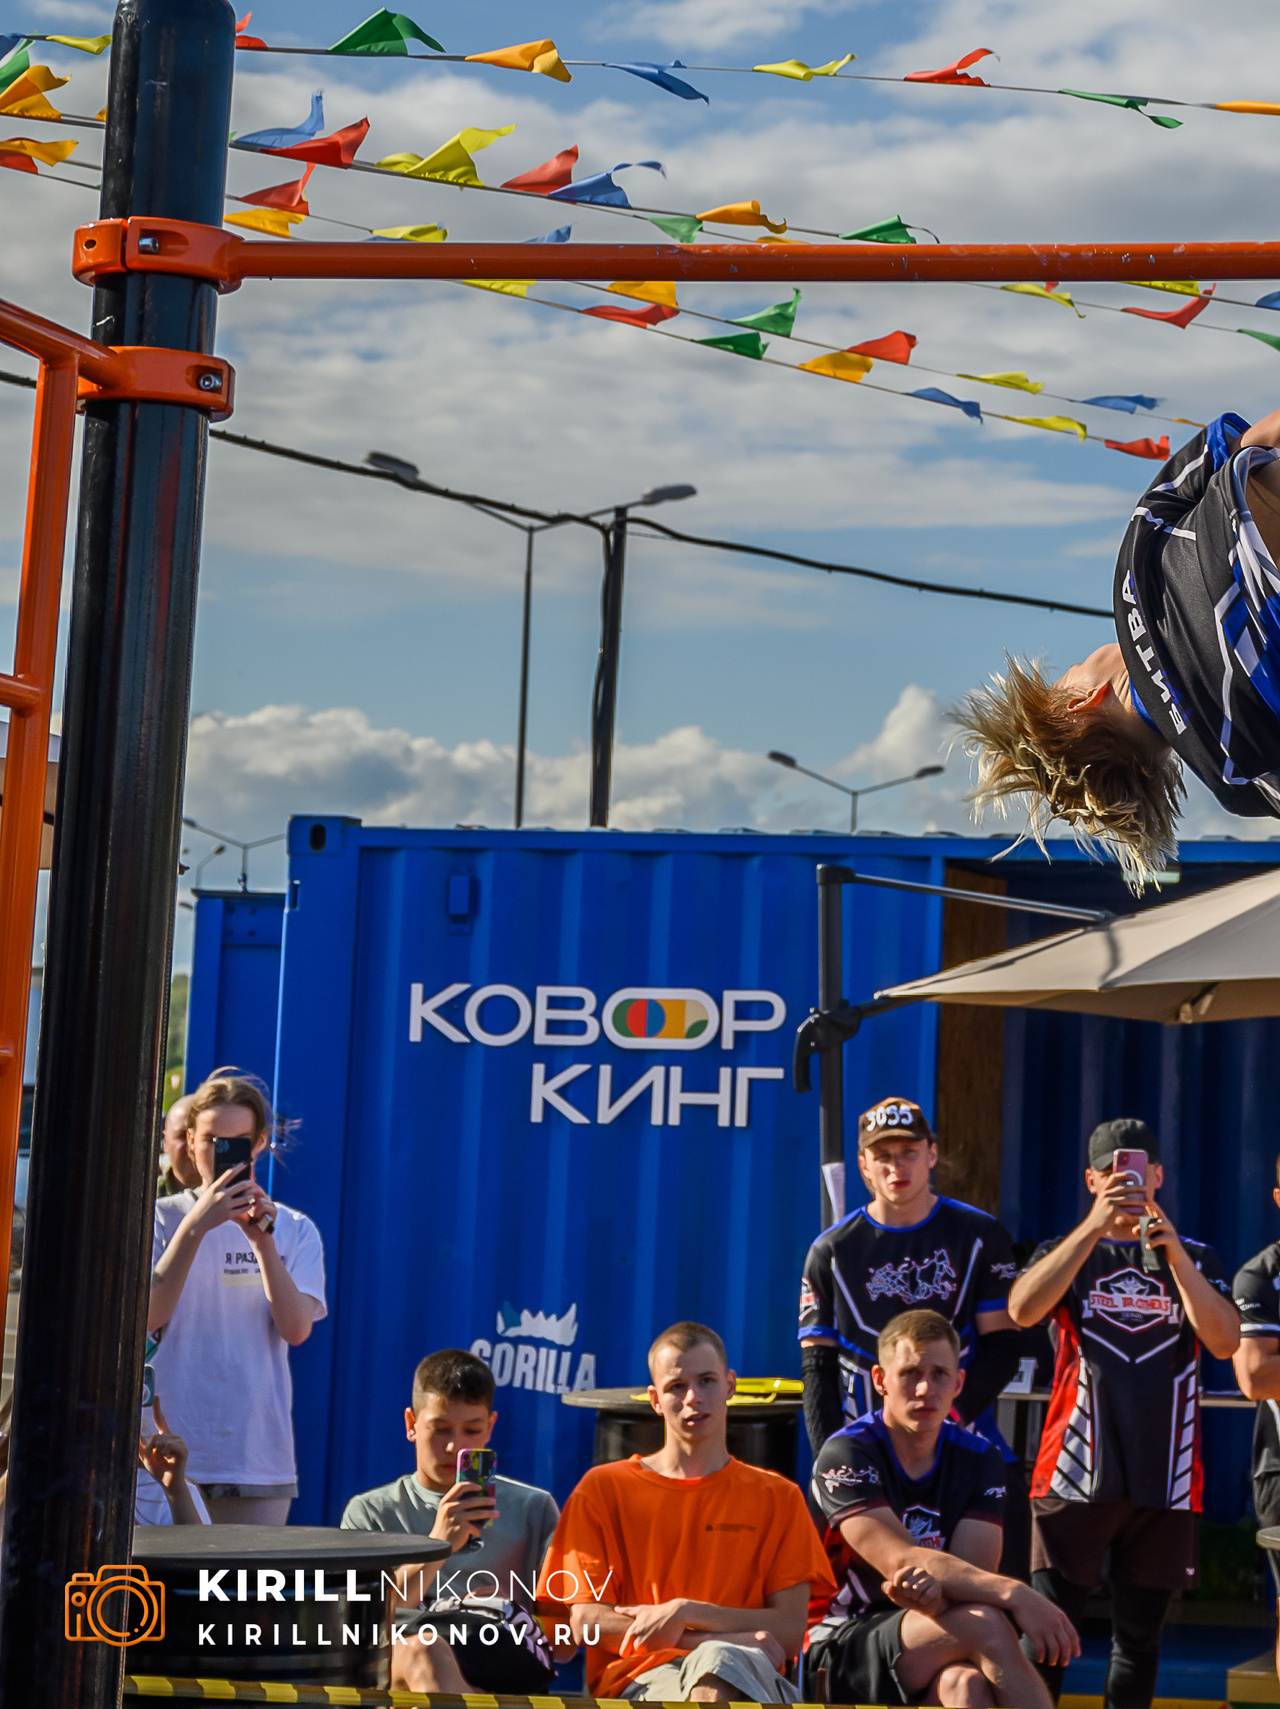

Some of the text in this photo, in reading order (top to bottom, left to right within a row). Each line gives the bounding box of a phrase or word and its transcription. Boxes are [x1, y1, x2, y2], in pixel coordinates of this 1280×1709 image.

[1122, 570, 1187, 735] БИТВА
[530, 1063, 784, 1127] КИНГ
[470, 1338, 596, 1394] GORILLA
